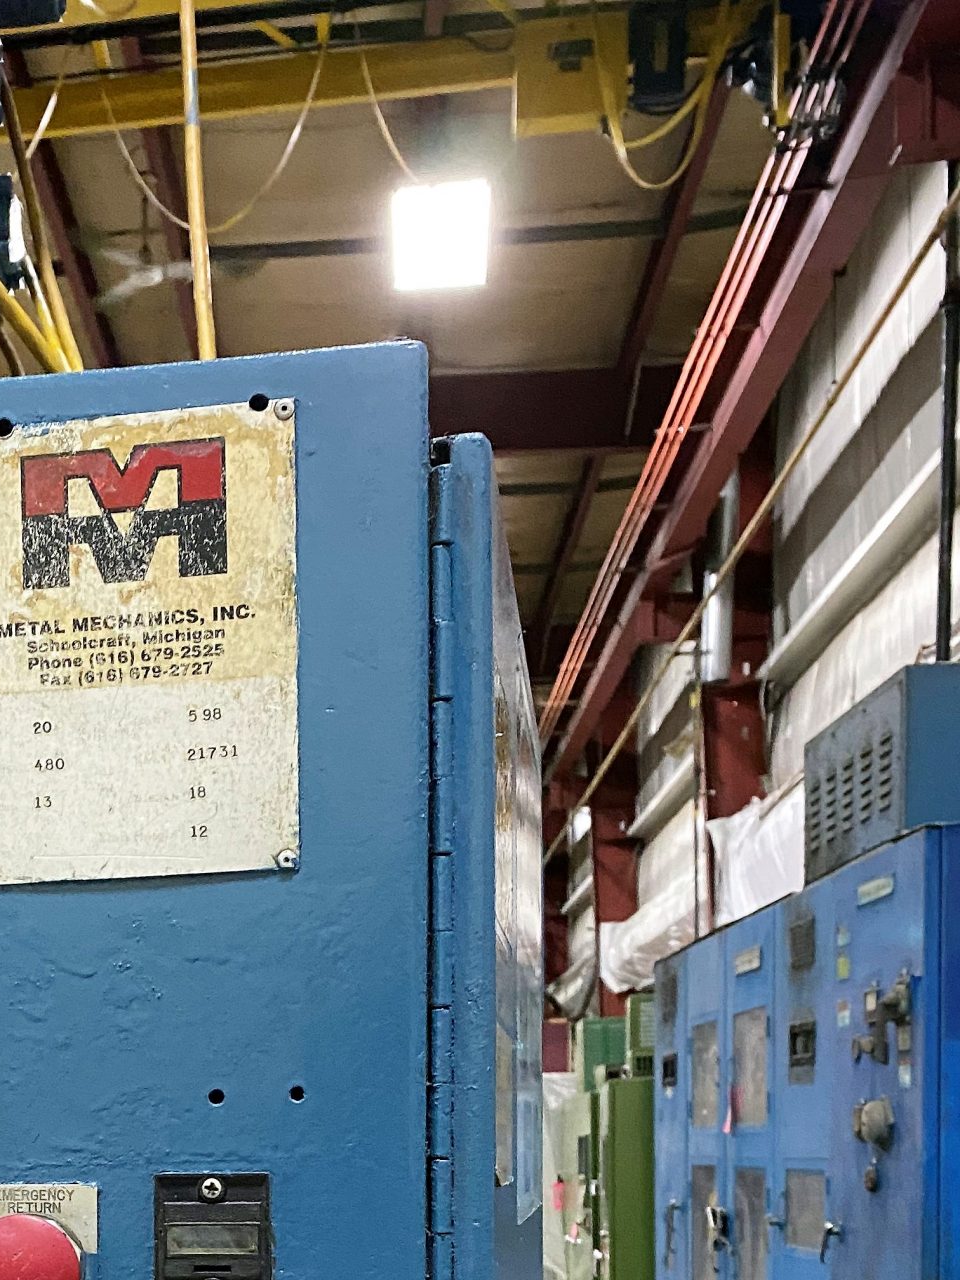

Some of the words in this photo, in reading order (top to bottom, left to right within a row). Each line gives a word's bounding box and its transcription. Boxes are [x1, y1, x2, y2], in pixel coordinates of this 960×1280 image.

[72, 608, 205, 633] MECHANICS,
[212, 603, 256, 621] INC.
[26, 633, 136, 654] Schoolcraft,
[142, 627, 225, 645] Michigan
[27, 656, 84, 671] Phone
[89, 649, 135, 669] (616)
[140, 642, 225, 662] 679-2525
[39, 673, 72, 686] Fax
[78, 667, 123, 686] (616)
[129, 660, 213, 680] 679-2727
[32, 720, 53, 735] 20
[186, 744, 240, 762] 21731
[34, 757, 66, 772] 480
[189, 785, 208, 800] 18
[34, 795, 53, 809] 13
[190, 825, 210, 838] 12
[7, 1201, 63, 1215] RETURN
